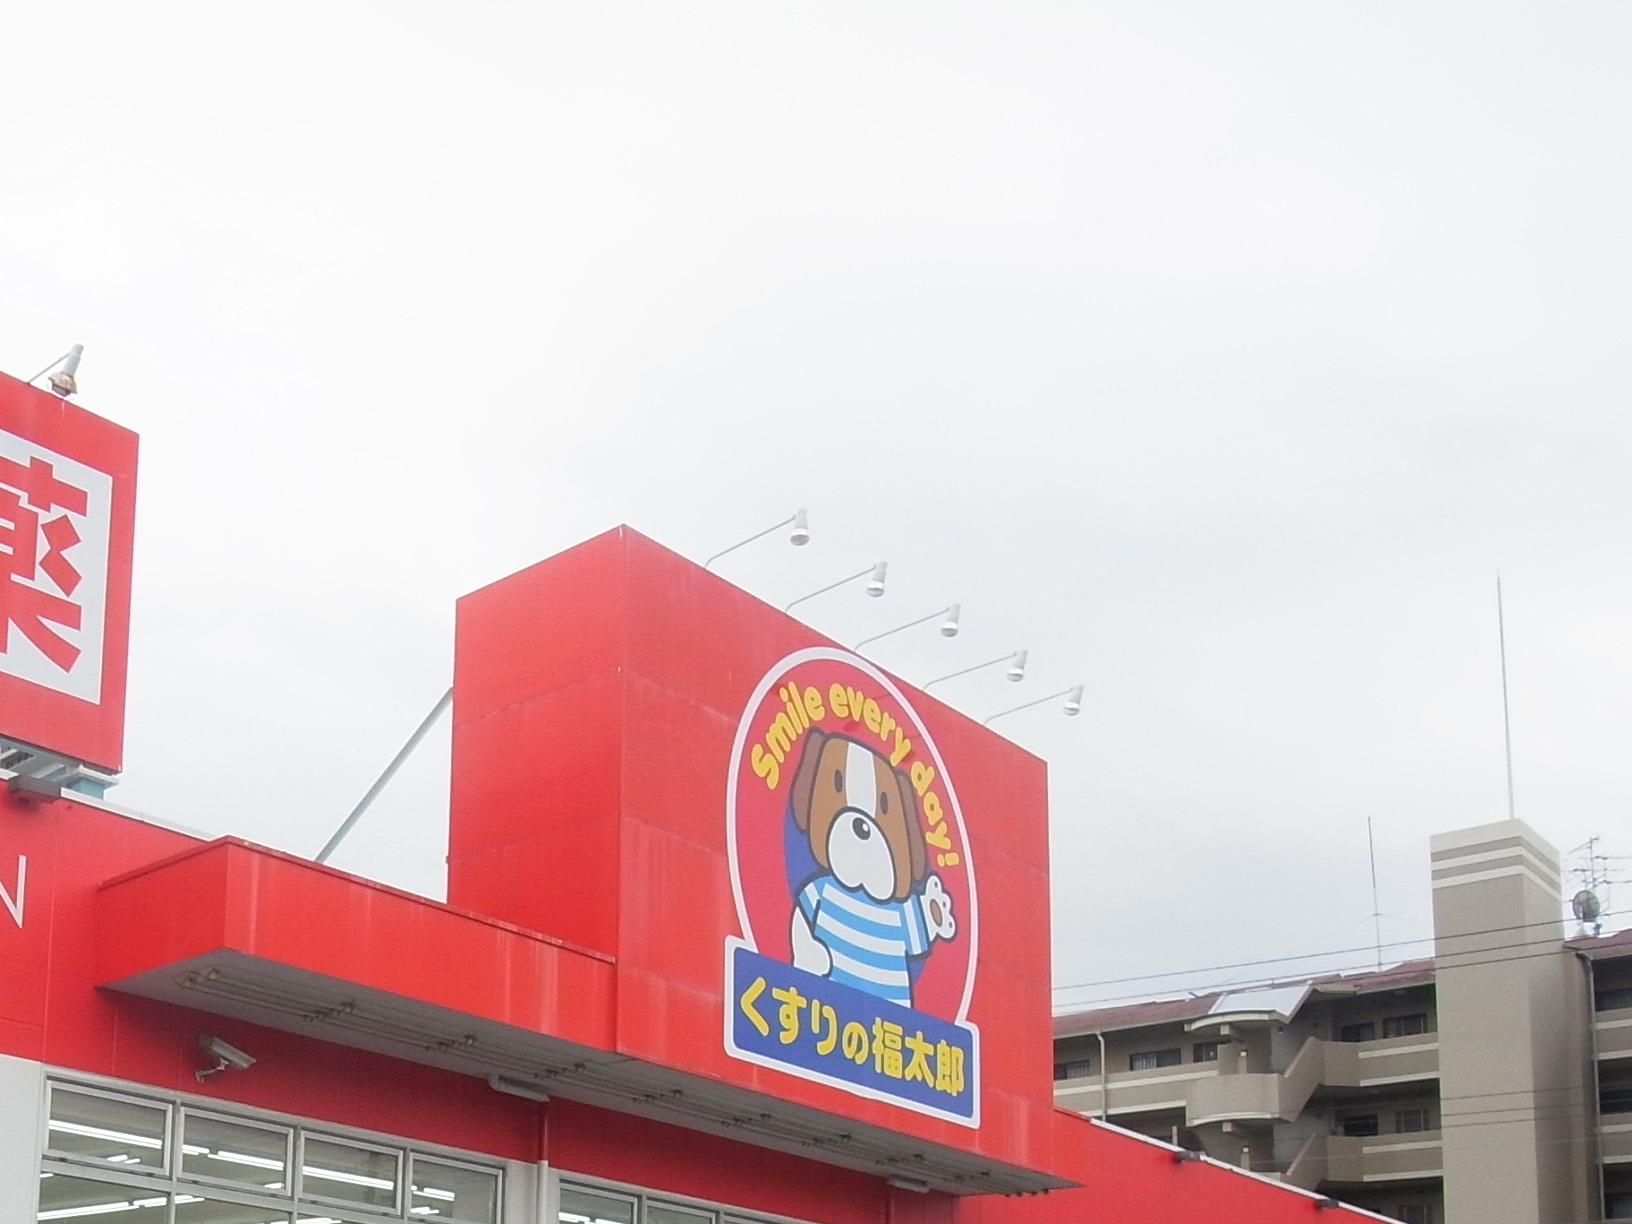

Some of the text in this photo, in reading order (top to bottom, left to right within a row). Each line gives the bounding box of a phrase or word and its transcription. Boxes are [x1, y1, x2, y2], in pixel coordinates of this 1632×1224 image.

[751, 681, 960, 867] Smile every day!
[739, 977, 965, 1097] くすりの福太郎
